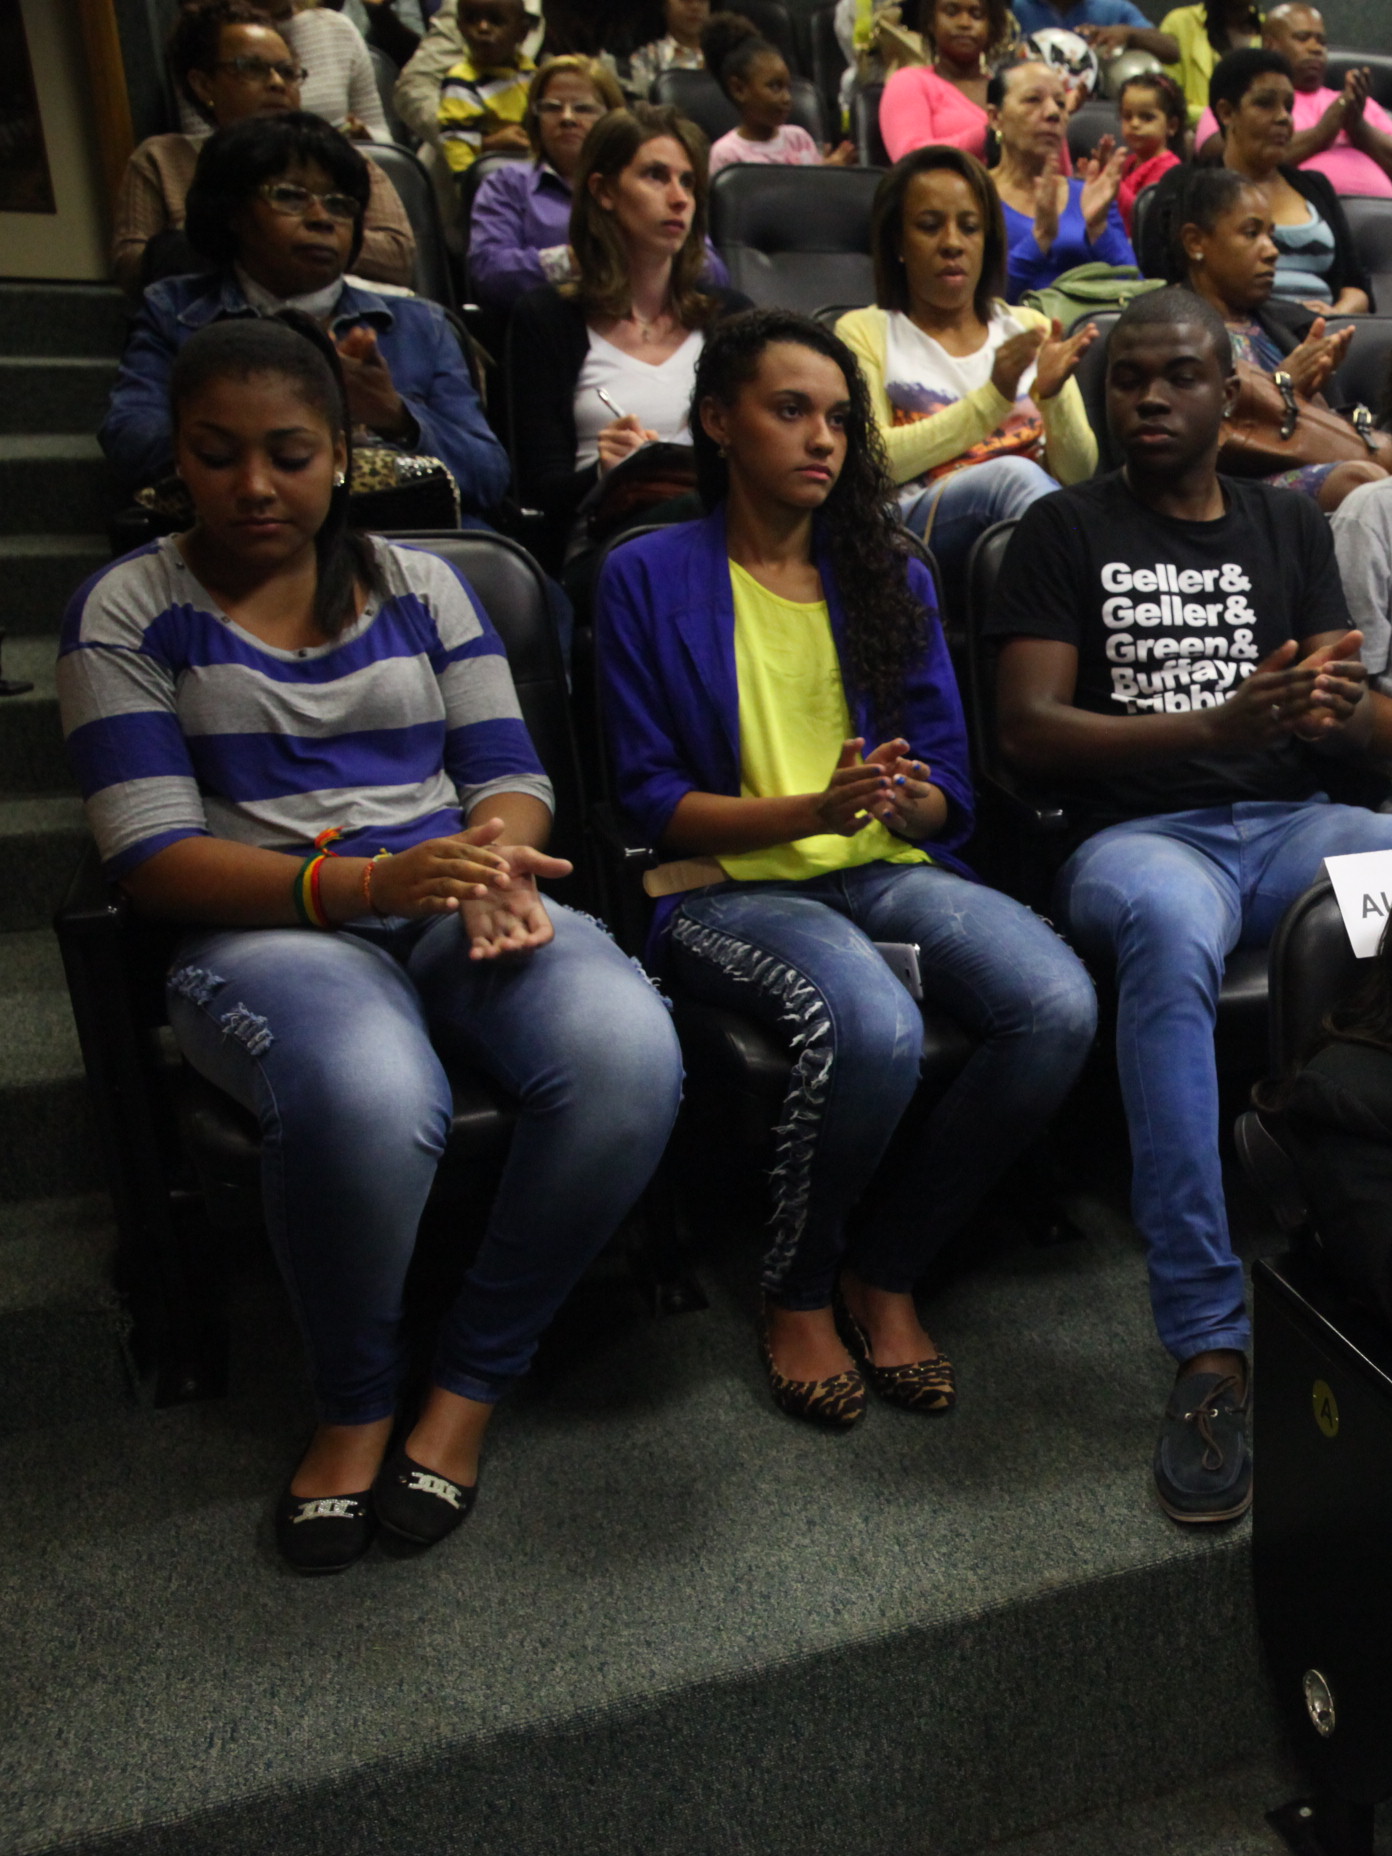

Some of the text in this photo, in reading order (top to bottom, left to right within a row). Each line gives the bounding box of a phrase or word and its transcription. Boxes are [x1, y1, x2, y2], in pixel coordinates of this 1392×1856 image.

[1101, 562, 1252, 593] Geller&
[1102, 595, 1257, 629] Geller&
[1105, 628, 1259, 663] Green&
[1111, 684, 1238, 714] Tribbi
[1320, 1397, 1333, 1429] A
